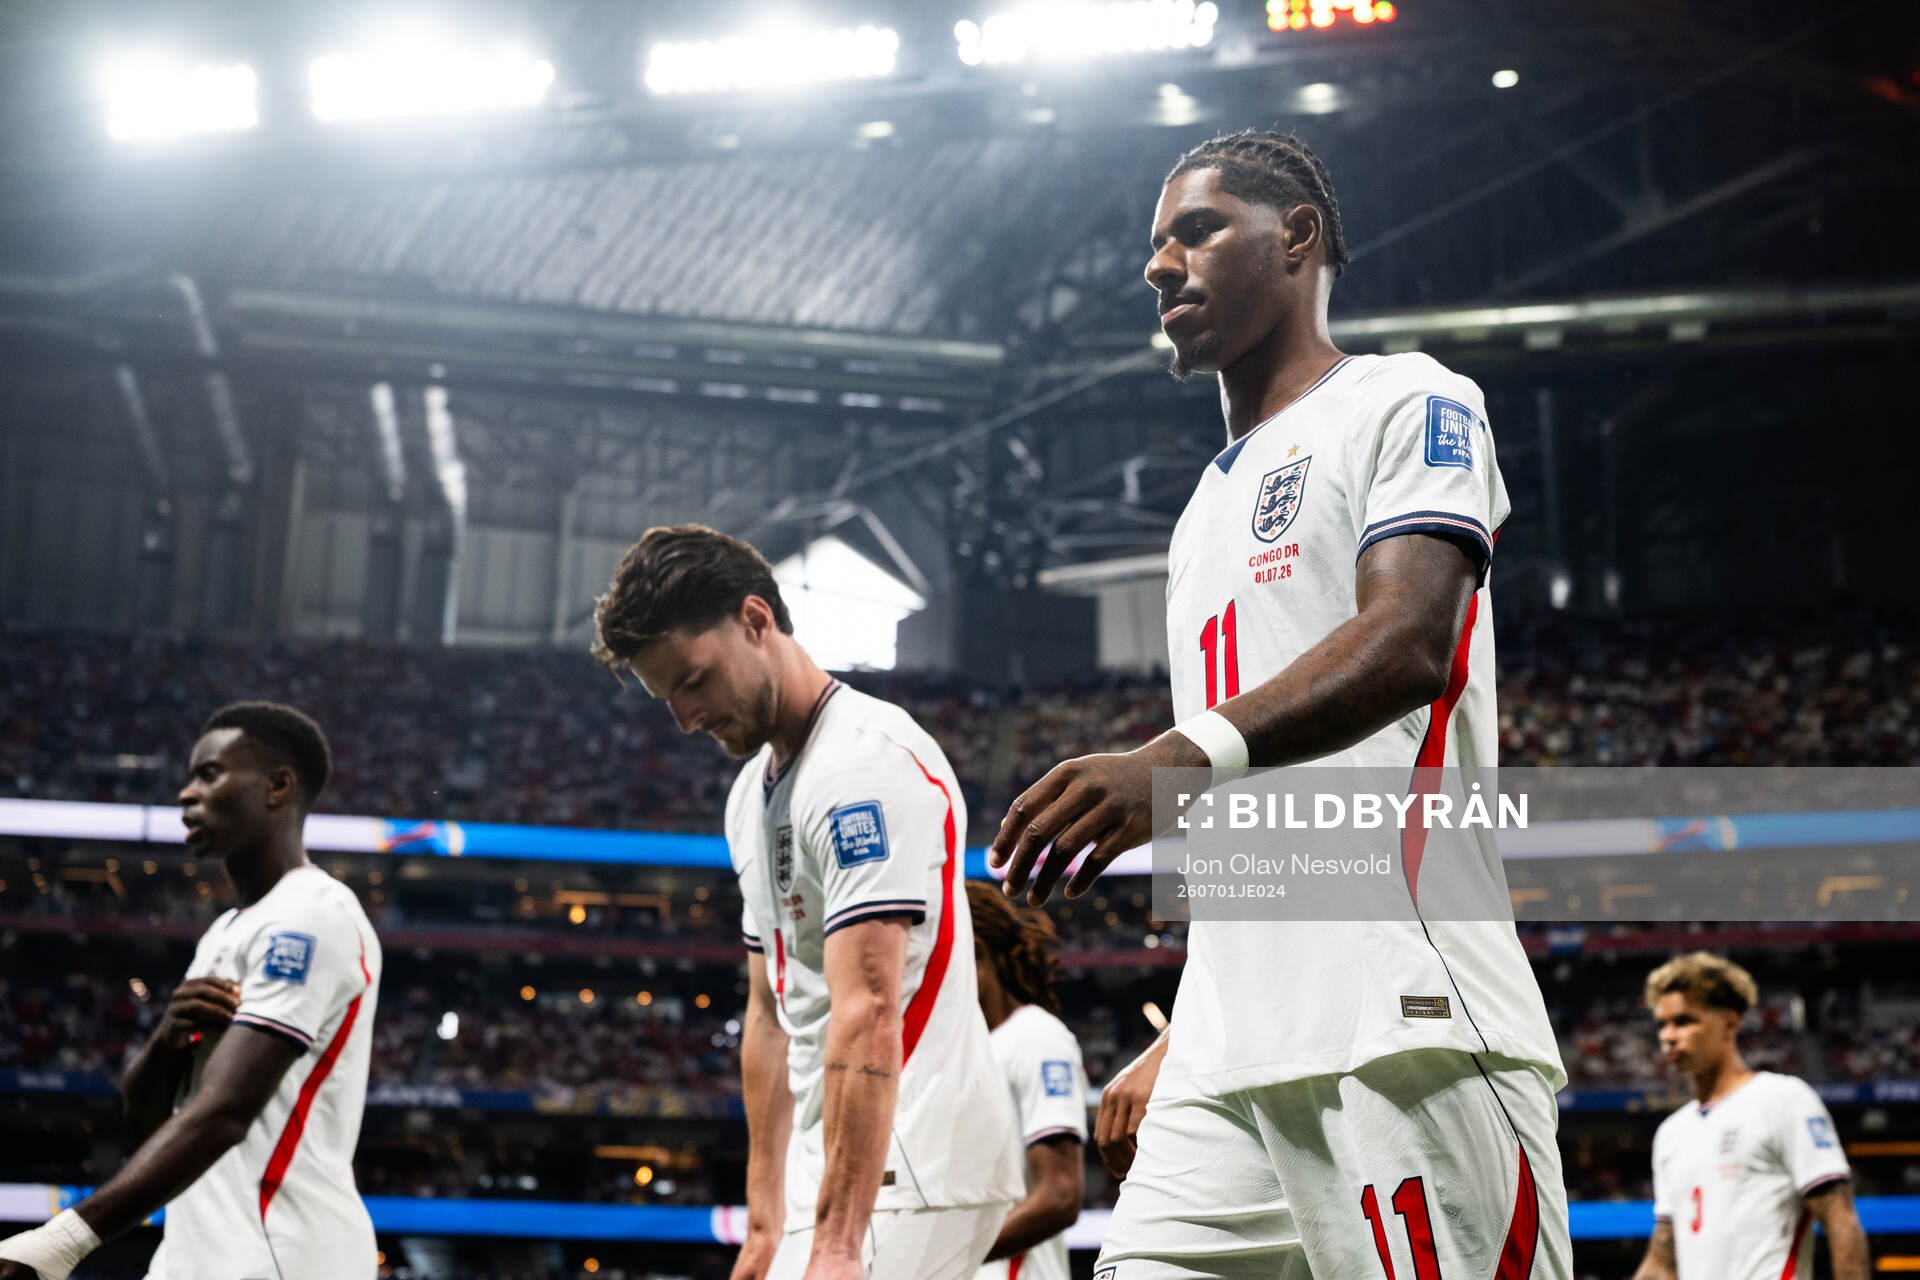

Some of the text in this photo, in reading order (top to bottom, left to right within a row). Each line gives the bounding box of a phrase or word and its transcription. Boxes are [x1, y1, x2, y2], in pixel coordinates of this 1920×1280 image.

[1436, 433, 1457, 446] the
[1440, 418, 1471, 439] UNIT
[1248, 543, 1300, 568] CONGO DR
[1255, 564, 1292, 584] 01.07.26
[1199, 598, 1241, 712] 11
[1360, 1175, 1443, 1280] 11
